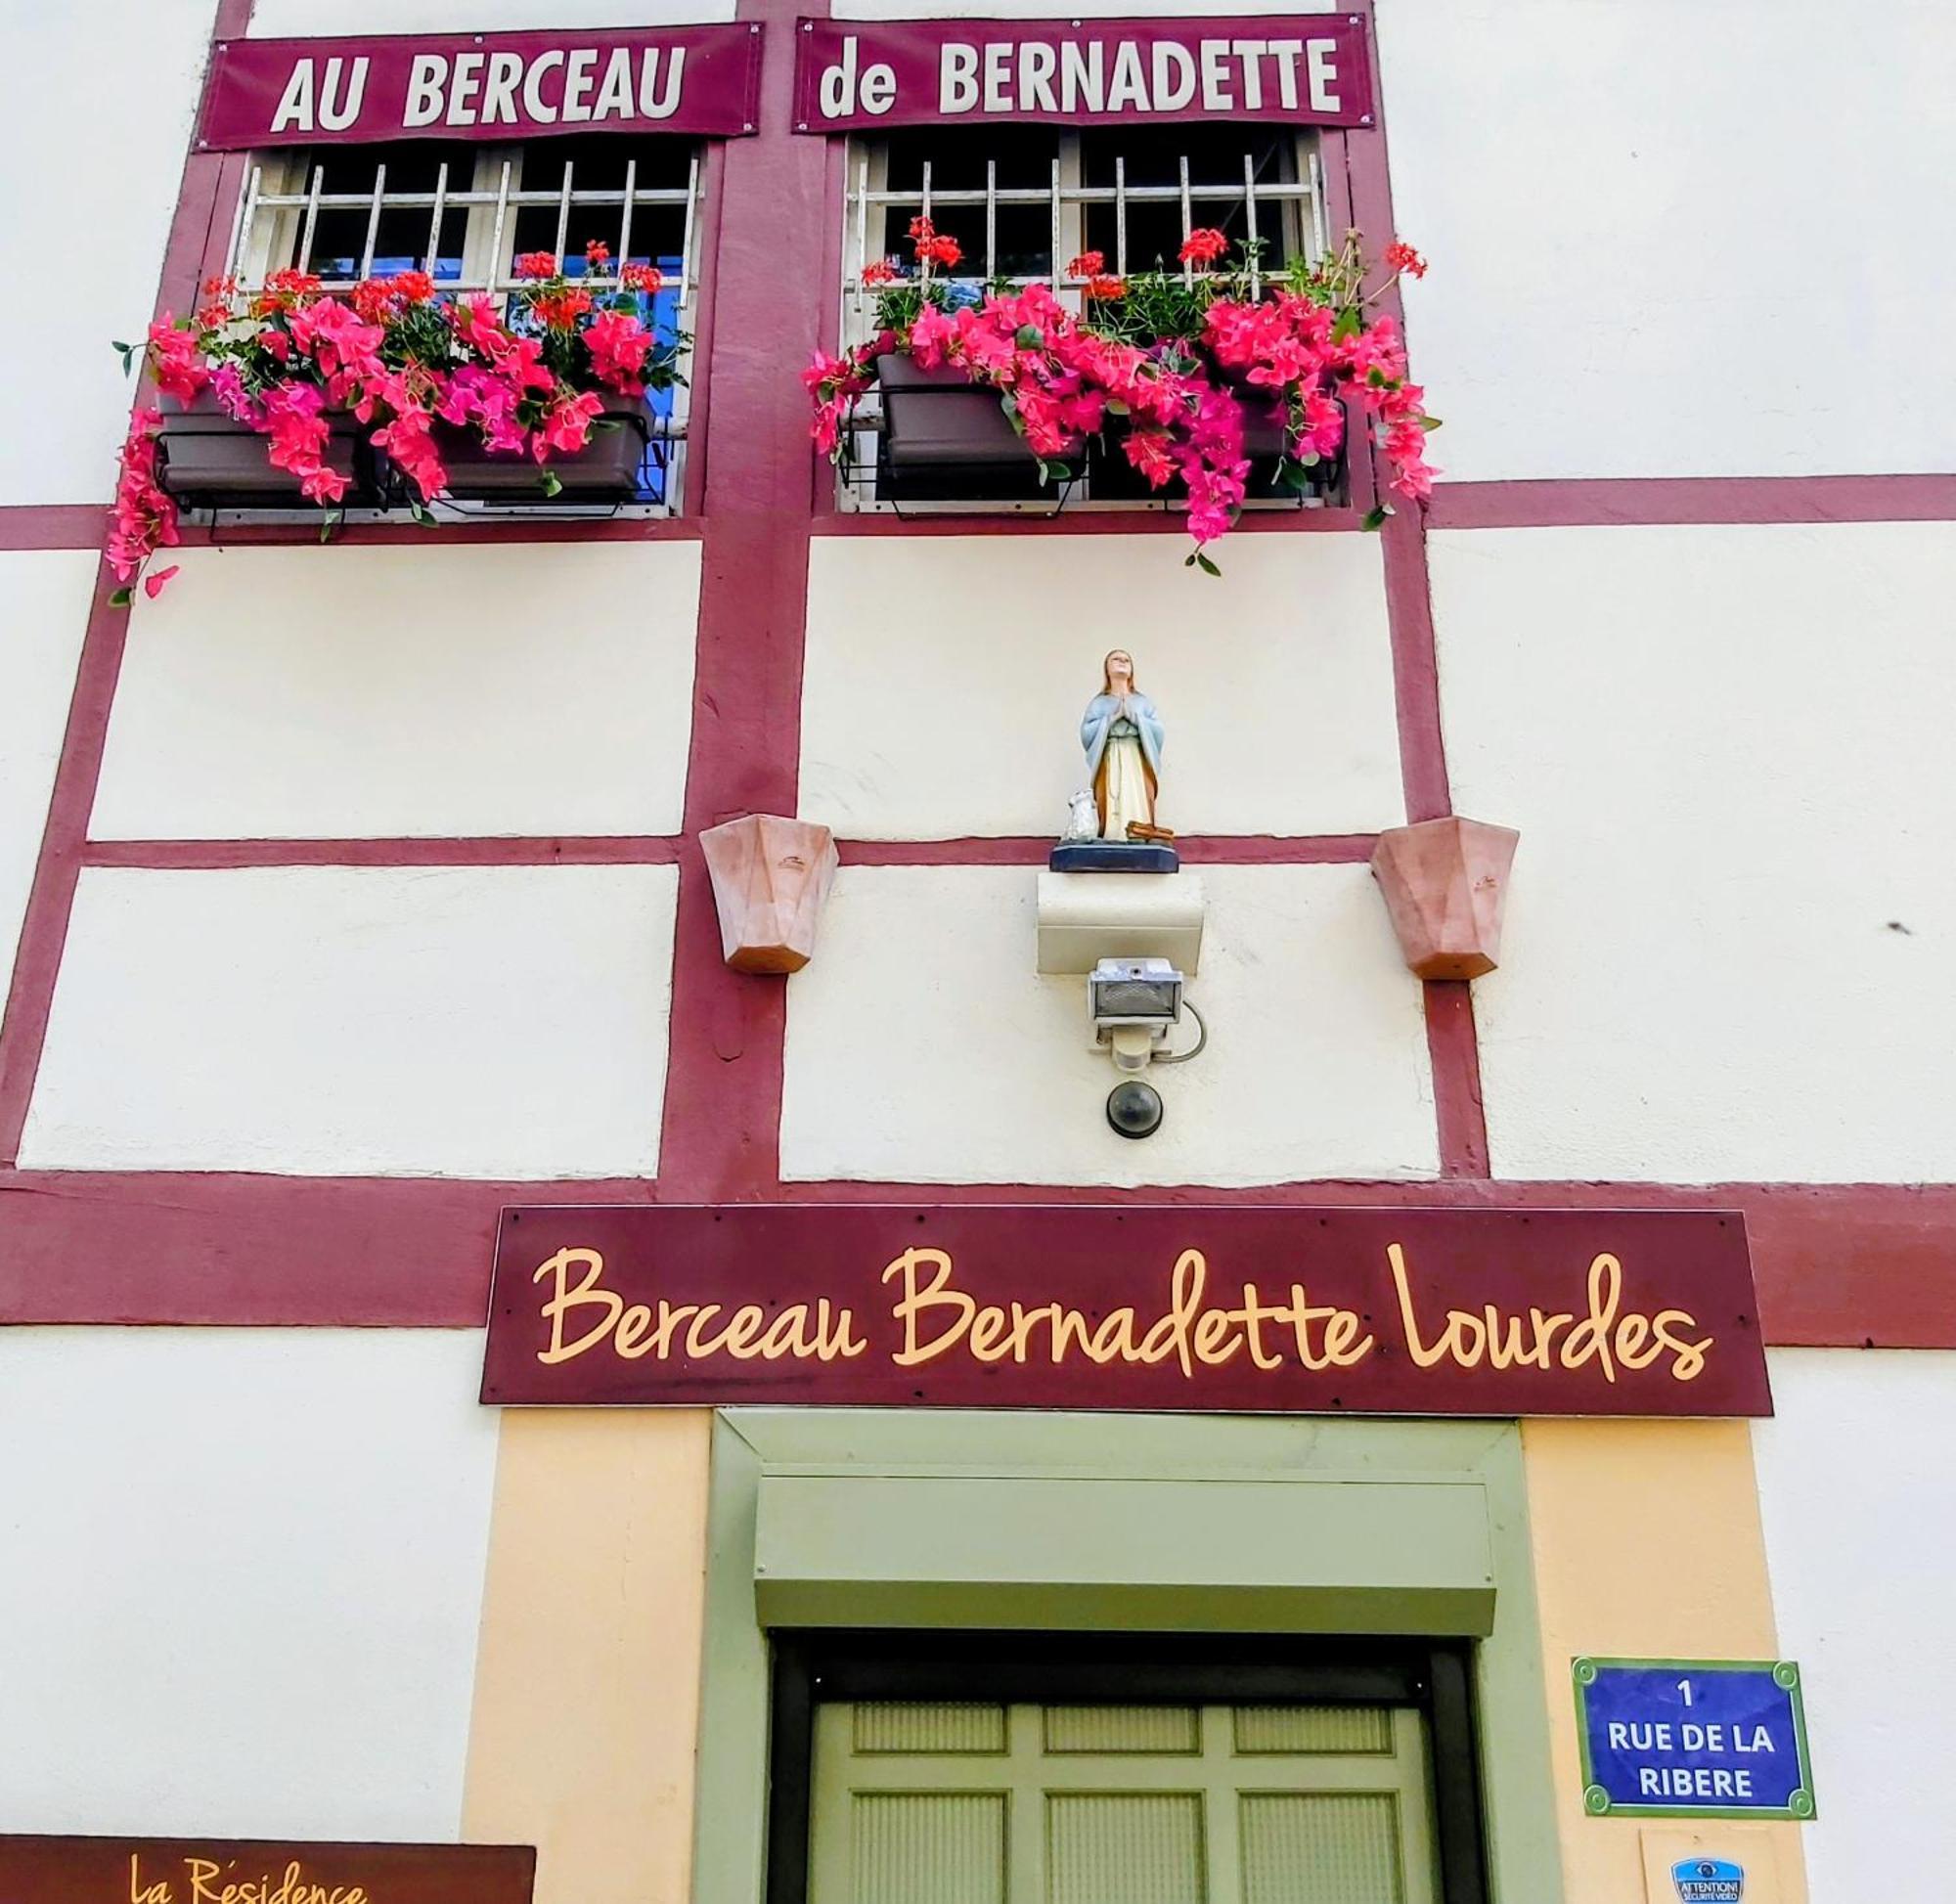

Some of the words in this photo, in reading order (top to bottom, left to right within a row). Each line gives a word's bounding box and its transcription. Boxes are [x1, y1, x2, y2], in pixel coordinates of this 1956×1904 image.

[271, 57, 370, 132] AU
[403, 47, 686, 127] BERCEAU
[820, 36, 896, 117] de
[939, 39, 1341, 113] BERNADETTE
[533, 1246, 867, 1365] Berceau
[881, 1246, 1373, 1380] Bernadette
[1386, 1243, 1713, 1382] Lourdes
[1676, 1679, 1693, 1706] 1
[1608, 1722, 1671, 1750] RUE
[1681, 1724, 1724, 1751] DE
[1732, 1725, 1775, 1752] LA
[1639, 1767, 1753, 1797] RIBERE
[129, 1853, 171, 1904] La
[184, 1857, 368, 1904] Résidence
